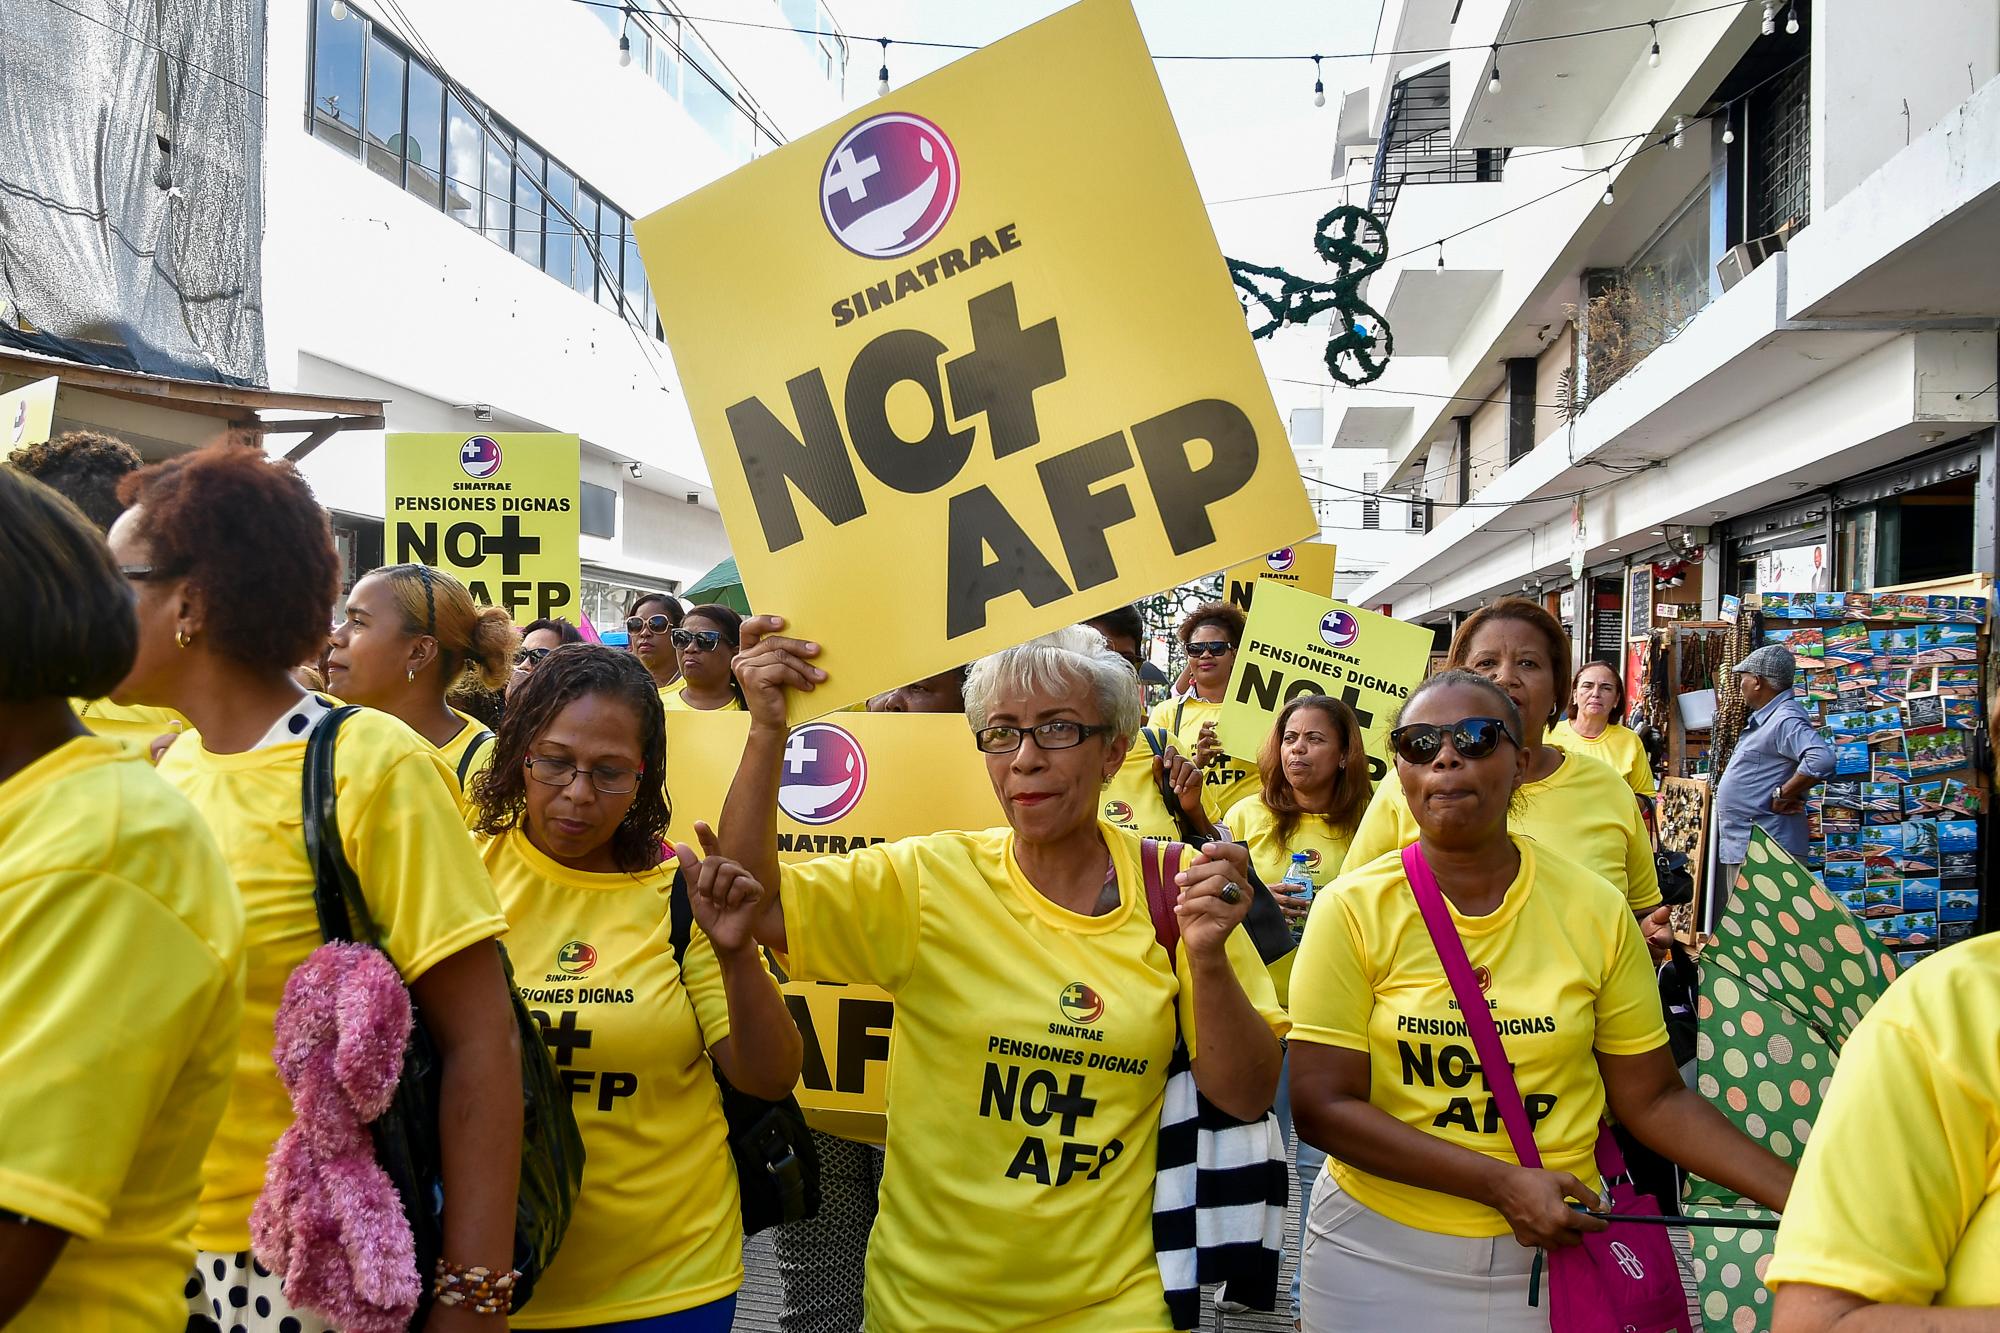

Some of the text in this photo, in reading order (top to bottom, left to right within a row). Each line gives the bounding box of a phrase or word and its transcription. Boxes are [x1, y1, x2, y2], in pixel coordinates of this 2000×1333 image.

[833, 223, 1022, 327] SINATRAE
[452, 482, 512, 491] SINATRAE
[395, 497, 571, 512] PENSIONES DIGNAS
[946, 399, 1259, 640] AFP
[1259, 572, 1300, 581] SINATRAE
[1306, 643, 1361, 666] SINATRAE
[1249, 640, 1409, 700] PENSIONES DIGNAS
[1205, 770, 1246, 786] AFP
[777, 833, 886, 855] NATRA
[518, 987, 635, 1004] SIONES DIGNAS
[1048, 1022, 1104, 1042] SINATRAE
[1397, 1015, 1471, 1037] PENSION
[988, 1036, 1149, 1075] PENSIONES DIGNAS
[560, 1070, 638, 1112] FP
[1004, 1136, 1124, 1187] AFP
